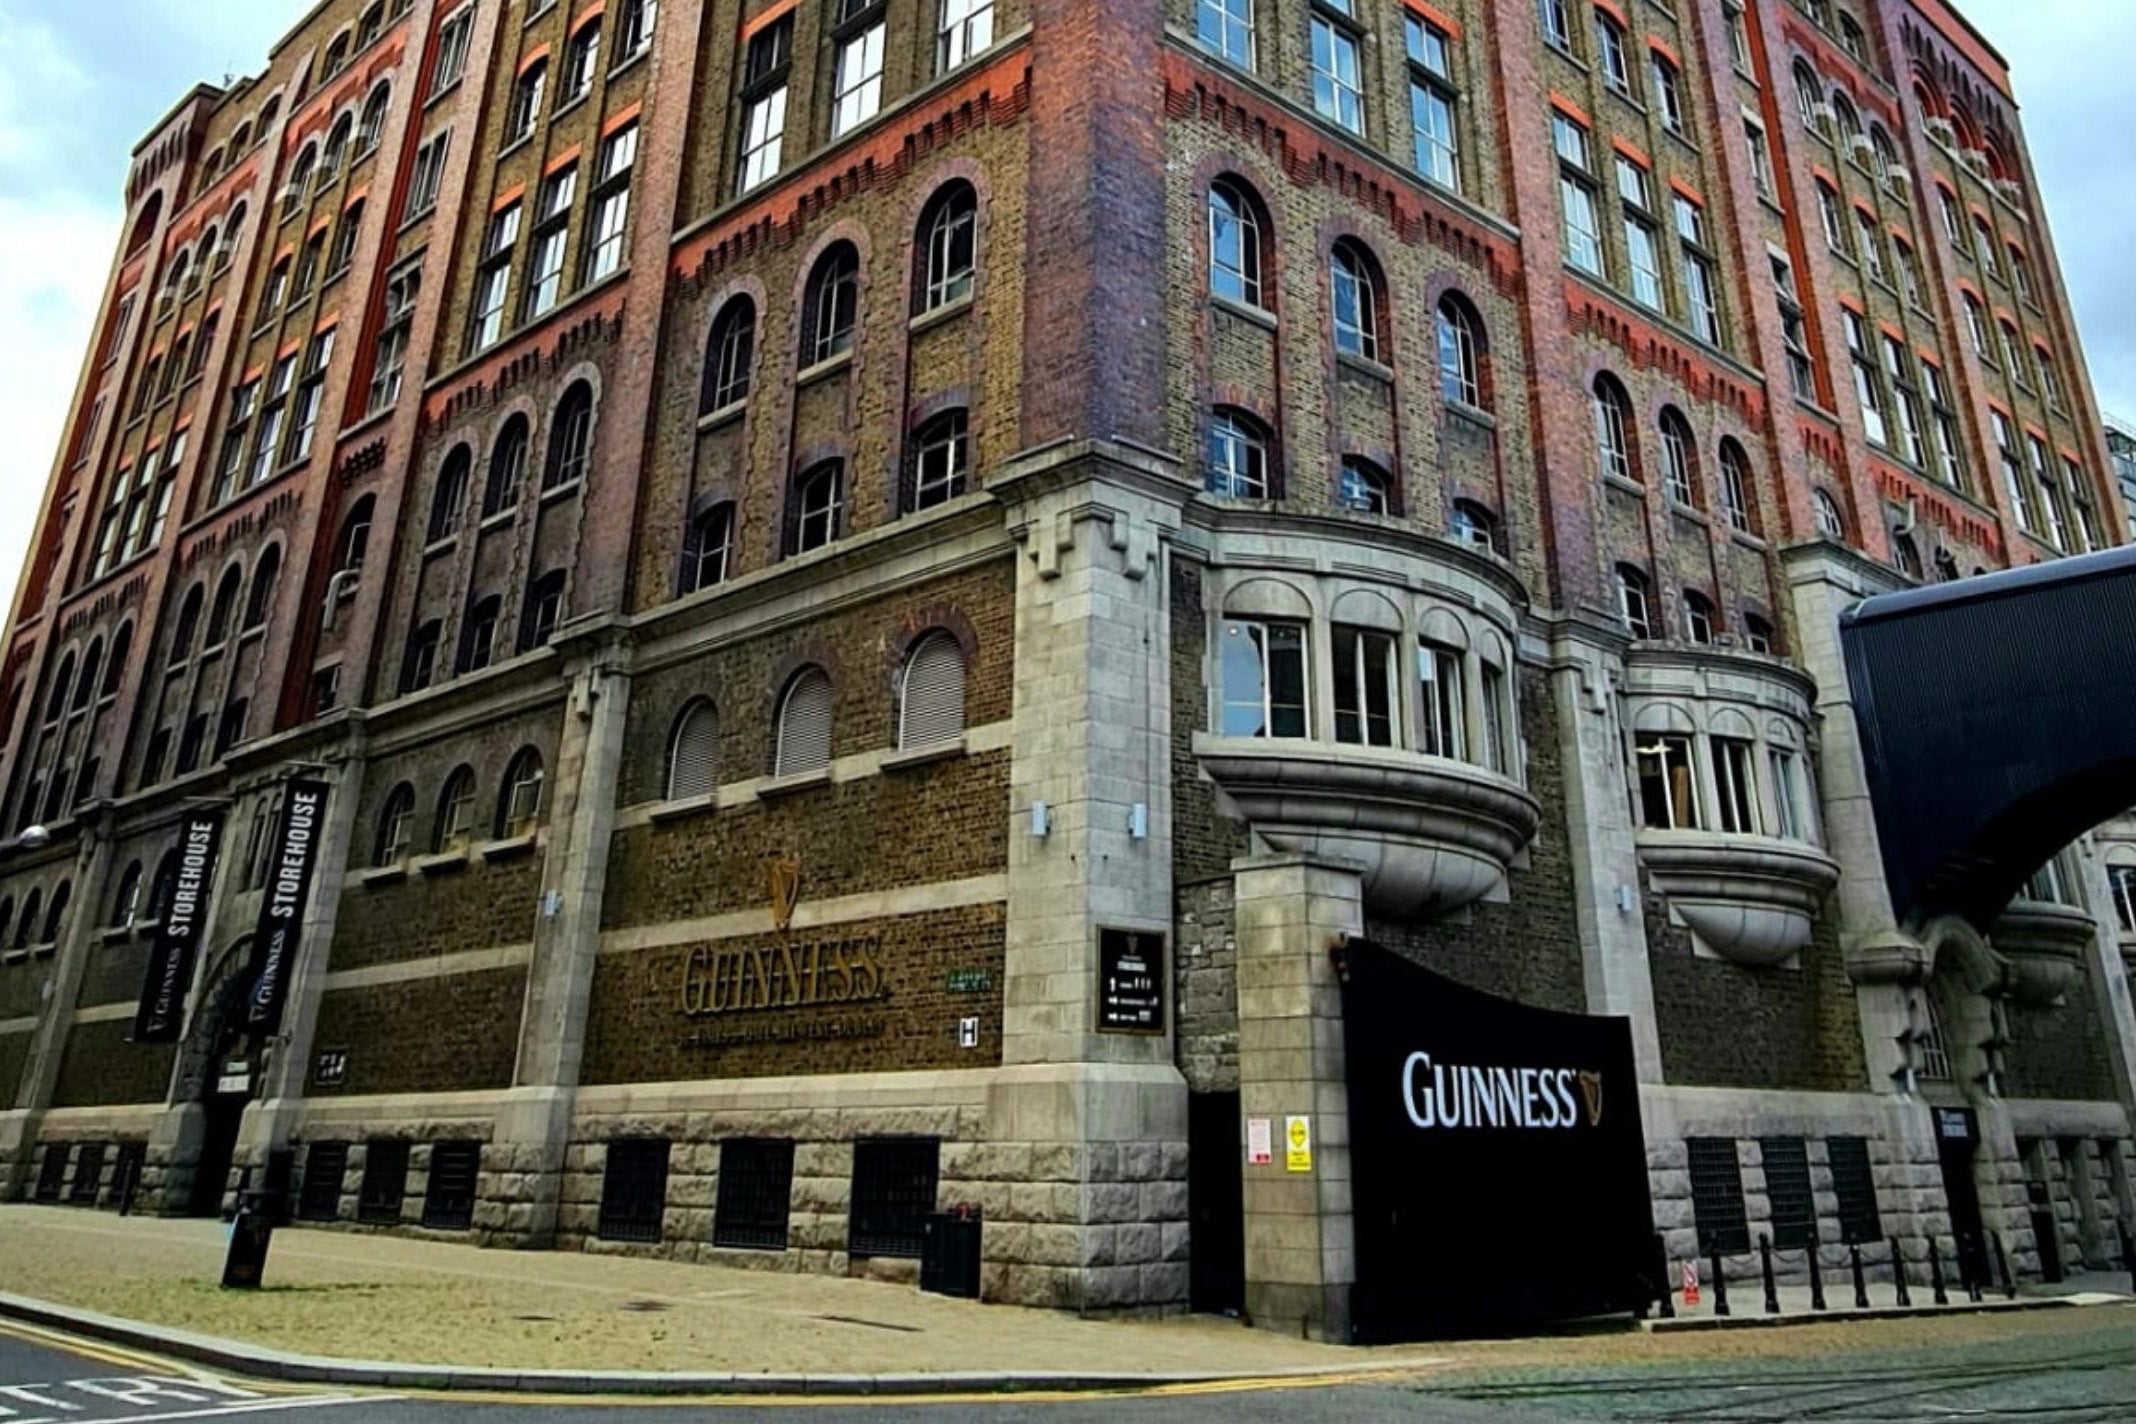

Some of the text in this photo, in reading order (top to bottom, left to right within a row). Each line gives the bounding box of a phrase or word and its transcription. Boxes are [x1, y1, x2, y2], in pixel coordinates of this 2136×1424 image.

[168, 820, 213, 938] STOREHOUSE
[257, 791, 318, 1004] GUINNESS STOREHOUSE
[682, 936, 884, 1015] GUINNESS
[1402, 1050, 1577, 1128] GUINNESS
